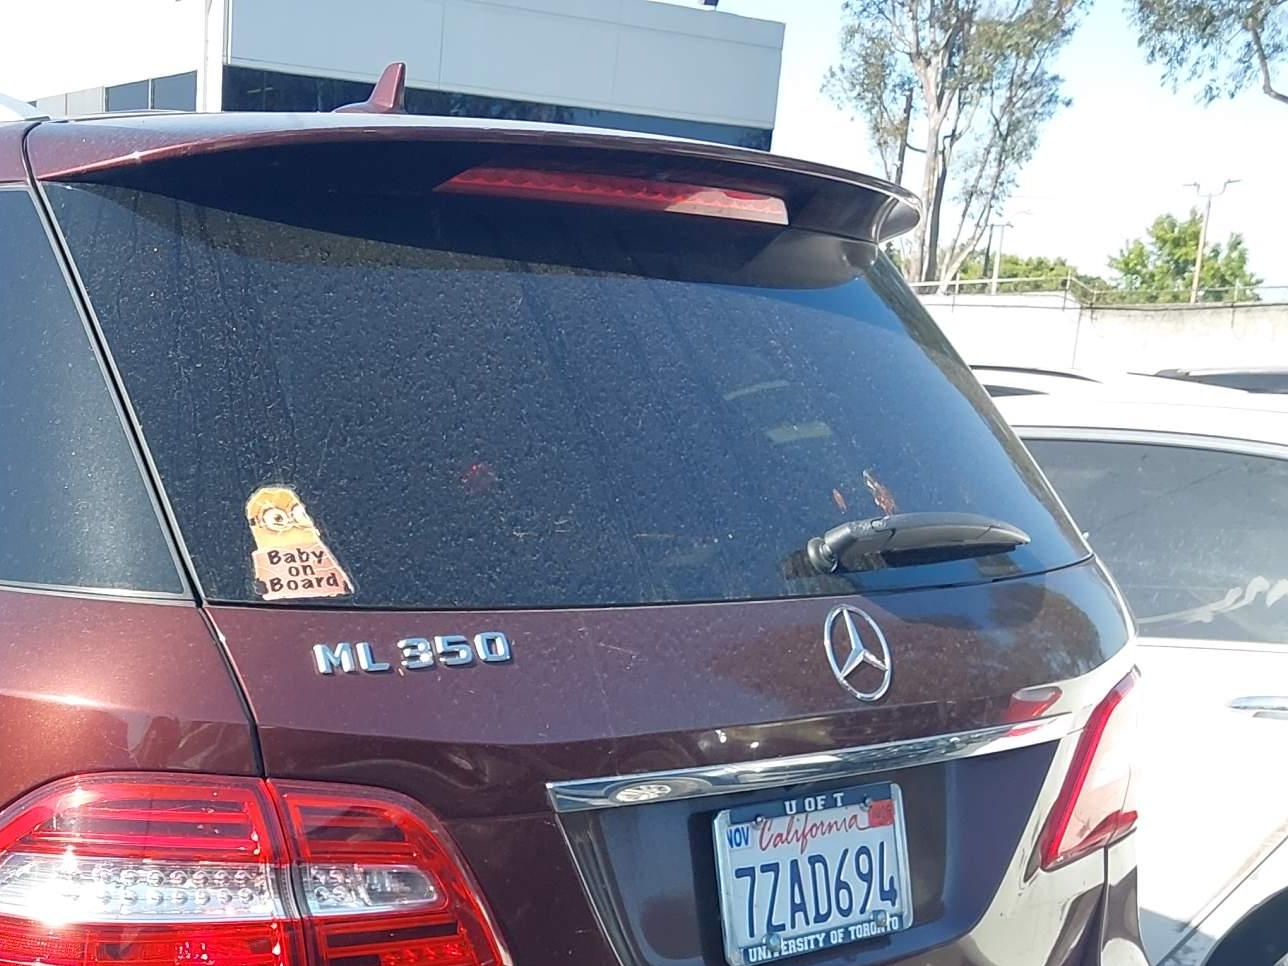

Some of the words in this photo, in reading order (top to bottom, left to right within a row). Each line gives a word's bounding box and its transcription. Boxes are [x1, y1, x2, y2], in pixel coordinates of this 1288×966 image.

[268, 548, 325, 566] Baby
[288, 564, 316, 577] on
[269, 572, 340, 593] Board
[313, 642, 391, 674] ML
[397, 631, 511, 670] 350
[785, 801, 797, 815] U
[804, 796, 826, 812] OF
[833, 793, 844, 807] T
[759, 814, 868, 855] California
[734, 841, 898, 938] 7ZAD694
[748, 932, 826, 963] UNERSITY
[830, 929, 849, 944] OF
